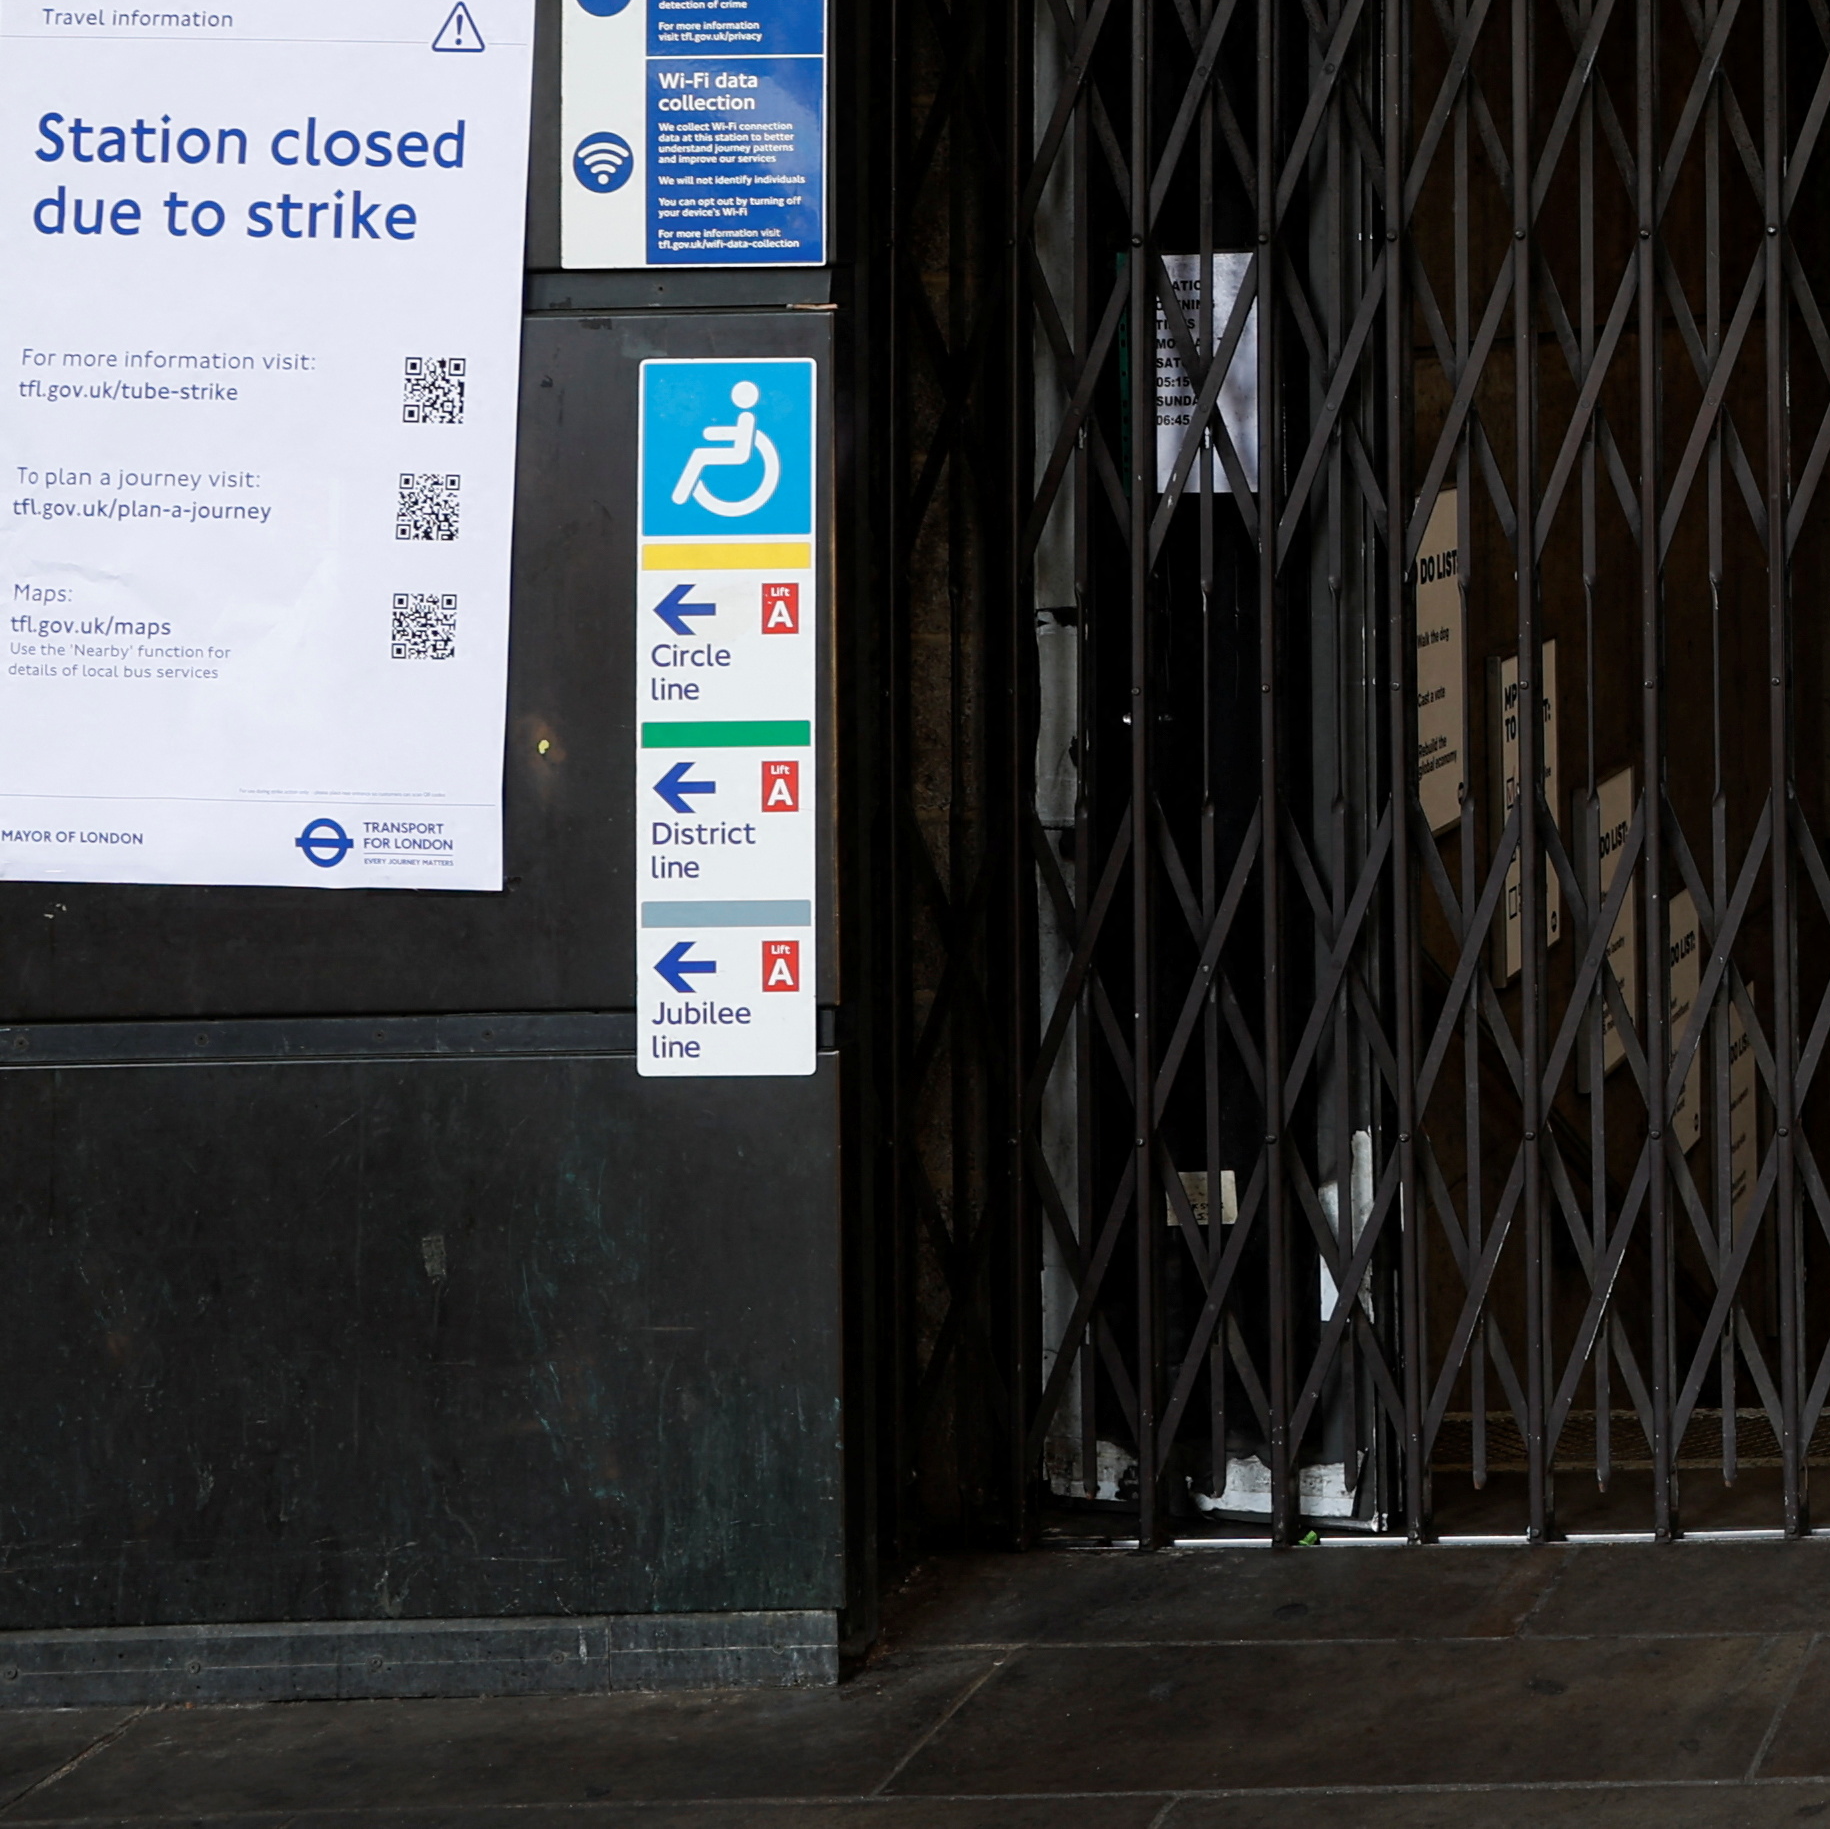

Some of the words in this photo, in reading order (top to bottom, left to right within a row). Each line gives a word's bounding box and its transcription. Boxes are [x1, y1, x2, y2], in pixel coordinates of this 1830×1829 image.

[658, 0, 705, 9] detection
[706, 0, 719, 9] of
[719, 0, 747, 9] crime
[42, 8, 105, 25] Travel
[112, 8, 232, 27] information
[658, 21, 674, 30] For
[703, 20, 760, 30] information
[658, 32, 679, 41] visit
[680, 30, 762, 43] tfl.gov.uk/privacy
[658, 72, 709, 89] Wi-Fi
[714, 72, 758, 88] data
[658, 93, 755, 111] collection
[34, 111, 247, 166] Station
[271, 115, 465, 169] closed
[33, 184, 141, 236] due
[163, 191, 225, 237] to
[247, 187, 416, 240] strike
[22, 348, 56, 366] For
[62, 353, 117, 367] more
[124, 349, 254, 369] information
[262, 353, 315, 370] visit:
[19, 378, 237, 400] tfl.gov.uk/tube-strike
[1157, 415, 1190, 425] 06:45
[16, 466, 38, 485] To
[45, 467, 91, 489] plan
[99, 472, 110, 485] a
[117, 469, 201, 491] journey
[208, 470, 260, 488] visit:
[12, 497, 271, 523] tfl.gov.uk/plan-a-journey
[1420, 557, 1434, 585] DO
[14, 583, 72, 606] Maps:
[769, 586, 790, 597] Lift
[767, 600, 793, 627] A
[10, 614, 170, 639] tfl.gov.uk/maps
[10, 642, 35, 655] Use
[40, 642, 65, 656] the
[70, 643, 132, 660] 'Nearby'
[137, 644, 203, 658] function
[207, 645, 230, 658] for
[651, 643, 731, 667] Circle
[8, 662, 57, 676] details
[61, 663, 78, 677] of
[82, 664, 118, 678] local
[123, 665, 151, 678] bus
[156, 666, 218, 679] services
[651, 677, 699, 700] line
[770, 764, 789, 774] Lift
[767, 778, 793, 805] A
[1, 829, 51, 842] MAYOR
[55, 830, 75, 843] OF
[80, 831, 143, 844] LONDON
[363, 821, 444, 834] TRANSPORT
[652, 821, 756, 845] District
[363, 837, 390, 848] FOR
[394, 838, 453, 850] LONDON
[363, 857, 386, 865] EVERY
[651, 855, 699, 879] line
[771, 944, 790, 954] Lift
[767, 958, 793, 985] A
[651, 1001, 751, 1025] Jubilee
[652, 1035, 700, 1058] line
